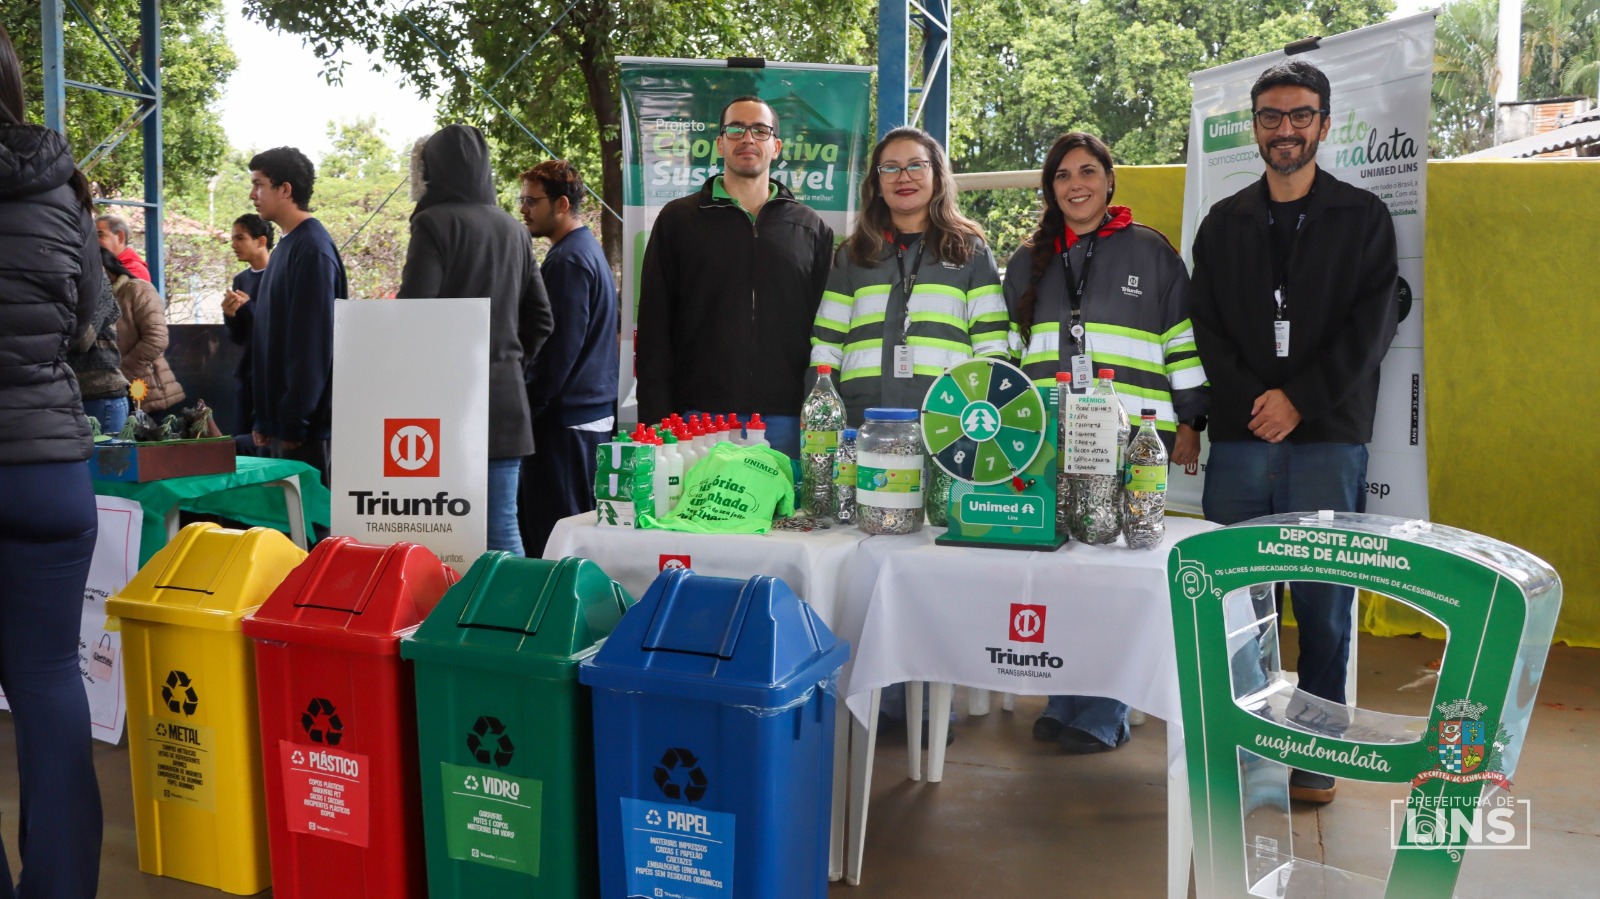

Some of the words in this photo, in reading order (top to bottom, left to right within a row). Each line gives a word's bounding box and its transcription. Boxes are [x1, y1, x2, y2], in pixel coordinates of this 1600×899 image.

[656, 119, 705, 133] Projeto
[1209, 118, 1254, 138] Unime
[652, 132, 838, 168] Cooptiva
[652, 160, 834, 191] Sustável
[1361, 166, 1396, 179] UNIMED
[1398, 163, 1418, 175] LINS
[1121, 286, 1143, 295] Triunfo
[968, 372, 979, 387] 3
[998, 378, 1012, 391] 4
[940, 391, 954, 404] 2
[1017, 407, 1031, 418] 5
[935, 426, 949, 434] 1
[954, 450, 966, 464] 8
[986, 456, 995, 471] 7
[744, 457, 779, 476] UNIMED
[348, 490, 471, 517] Triunfo
[969, 501, 1019, 513] Unimed
[366, 521, 454, 534] TRANSBRASILIANA
[1279, 528, 1347, 547] DEPOSITE
[1350, 534, 1389, 551] AQUI
[1258, 540, 1310, 559] LACRES
[1314, 547, 1333, 561] DE
[1336, 551, 1411, 571] ALUMÍNIO.
[1224, 566, 1248, 575] LACRES
[1250, 565, 1298, 573] ARRECADADOS
[1300, 564, 1314, 573] SÃO
[1315, 566, 1357, 579] REVERTIDOS
[1358, 572, 1369, 581] EM
[1370, 573, 1390, 585] ITENS
[1390, 579, 1401, 588] DE
[1401, 583, 1461, 607] ACESSIBILIDADE.
[985, 646, 1064, 669] Triunfo
[997, 667, 1053, 679] TRANSBRASILIANA
[168, 723, 202, 746] METAL
[1255, 733, 1392, 773] euajudonalata
[308, 750, 359, 778] PLÁSTICO
[308, 778, 323, 787] COPOS
[482, 775, 520, 800] VIDRO
[473, 817, 487, 825] POTES
[492, 820, 509, 829] COPOS
[667, 810, 712, 836] PAPEL
[501, 830, 515, 839] VIDRO
[650, 837, 677, 847] MATERIAIS
[678, 841, 708, 853] IMPRESSOS
[655, 845, 674, 855] CAIXAS
[666, 855, 692, 866] CARTAZES
[647, 860, 681, 872] EMBALAGENS
[681, 866, 698, 875] LONGA
[699, 868, 711, 878] VIDA
[654, 870, 666, 878] SEM
